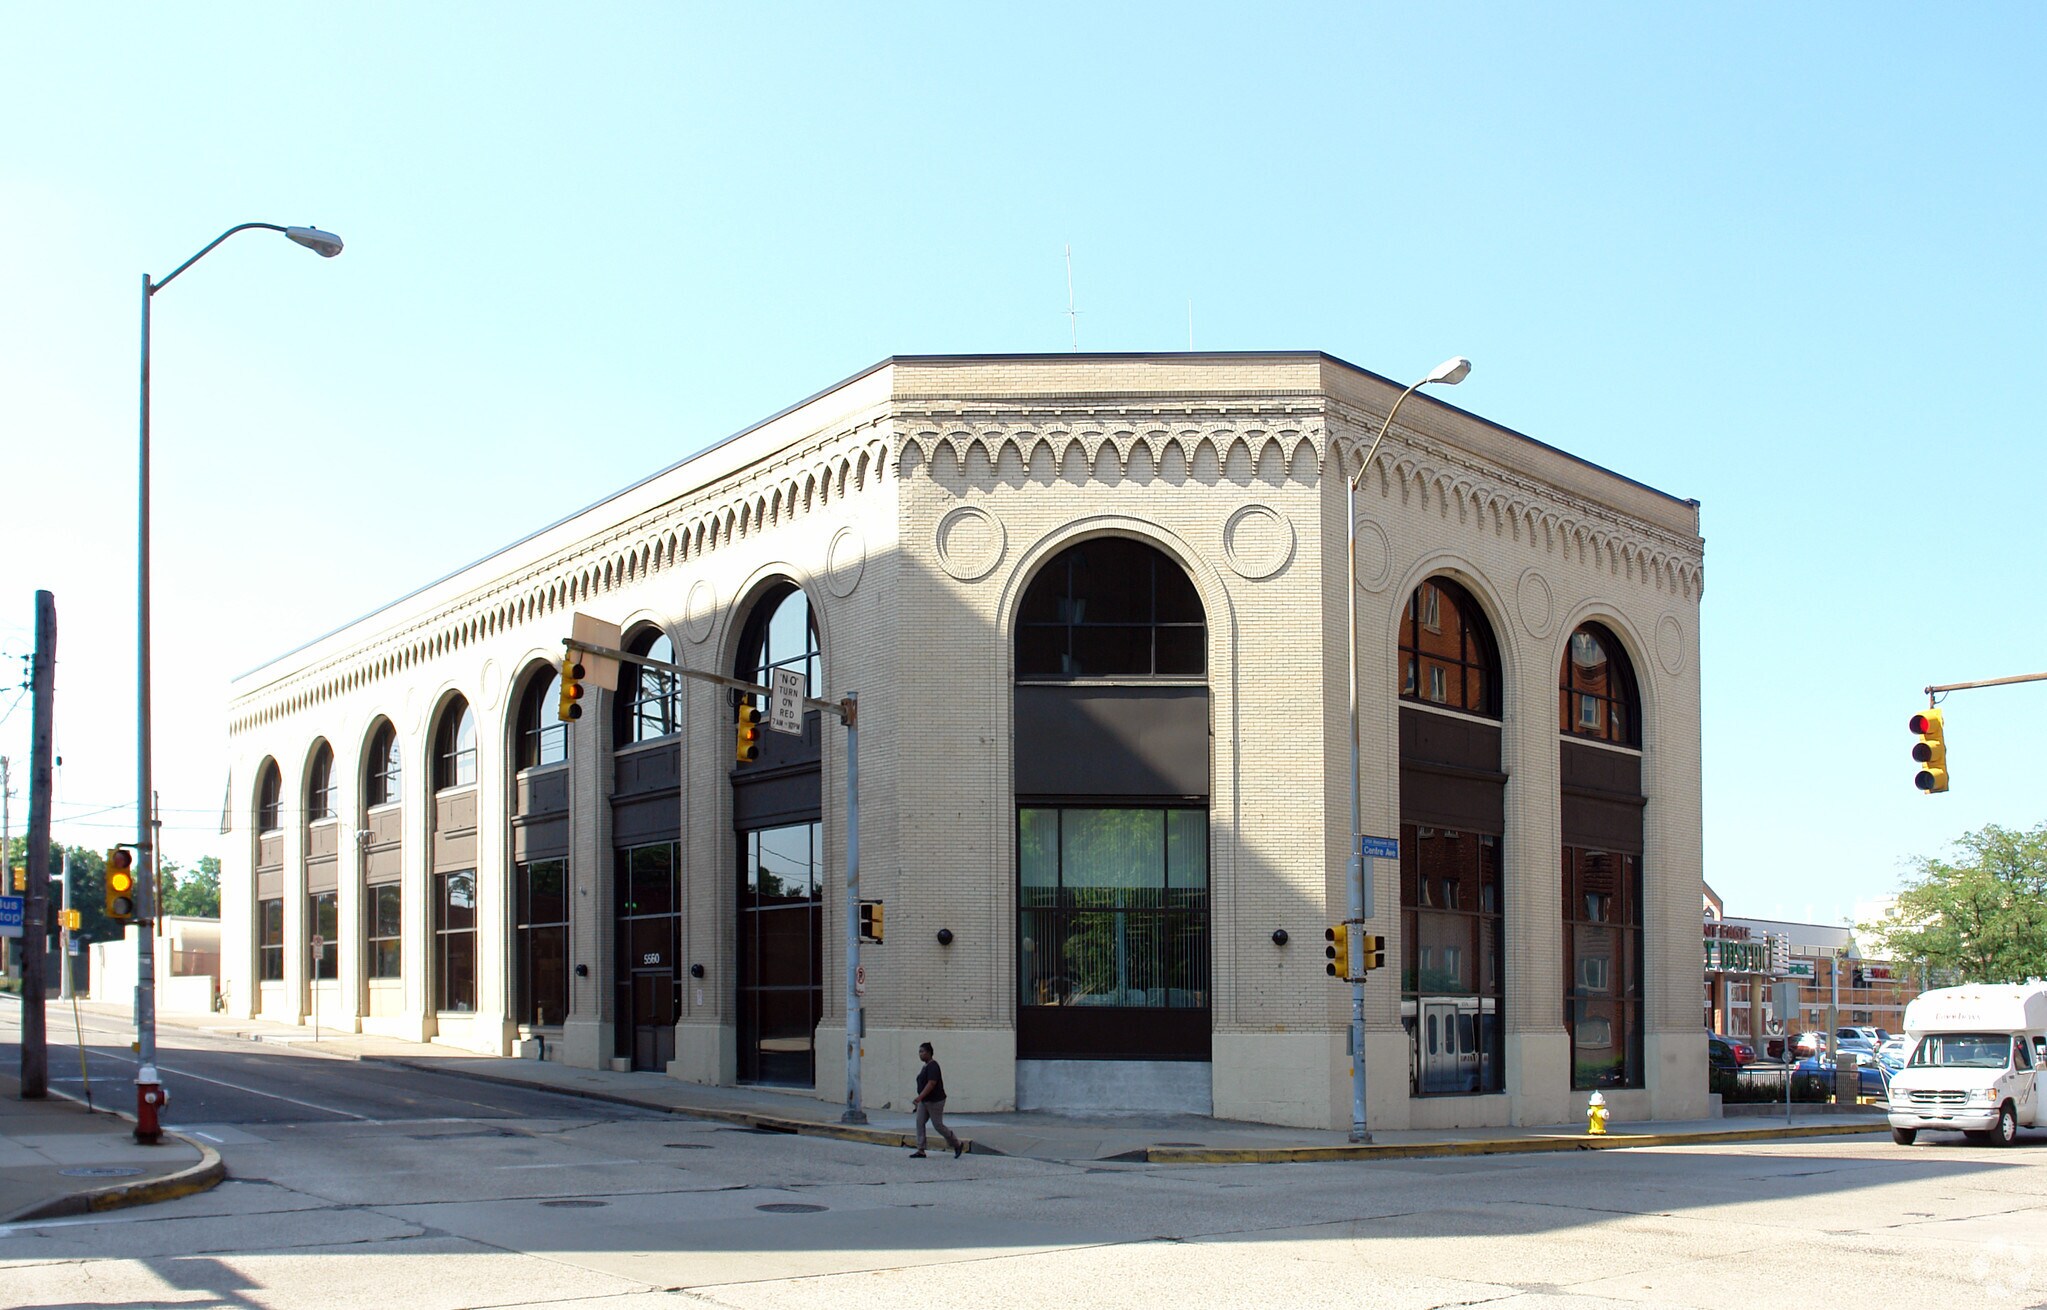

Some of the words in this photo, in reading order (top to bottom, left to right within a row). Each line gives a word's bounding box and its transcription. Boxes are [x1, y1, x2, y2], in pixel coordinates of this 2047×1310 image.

[782, 674, 797, 686] NO
[779, 686, 798, 697] TURN
[782, 698, 793, 707] ON
[780, 708, 795, 719] RED
[1364, 846, 1384, 856] Centre
[1386, 848, 1396, 856] Ave
[0, 912, 20, 924] top
[1720, 925, 1751, 940] EAGLE
[1720, 936, 1775, 972] DISTRICT
